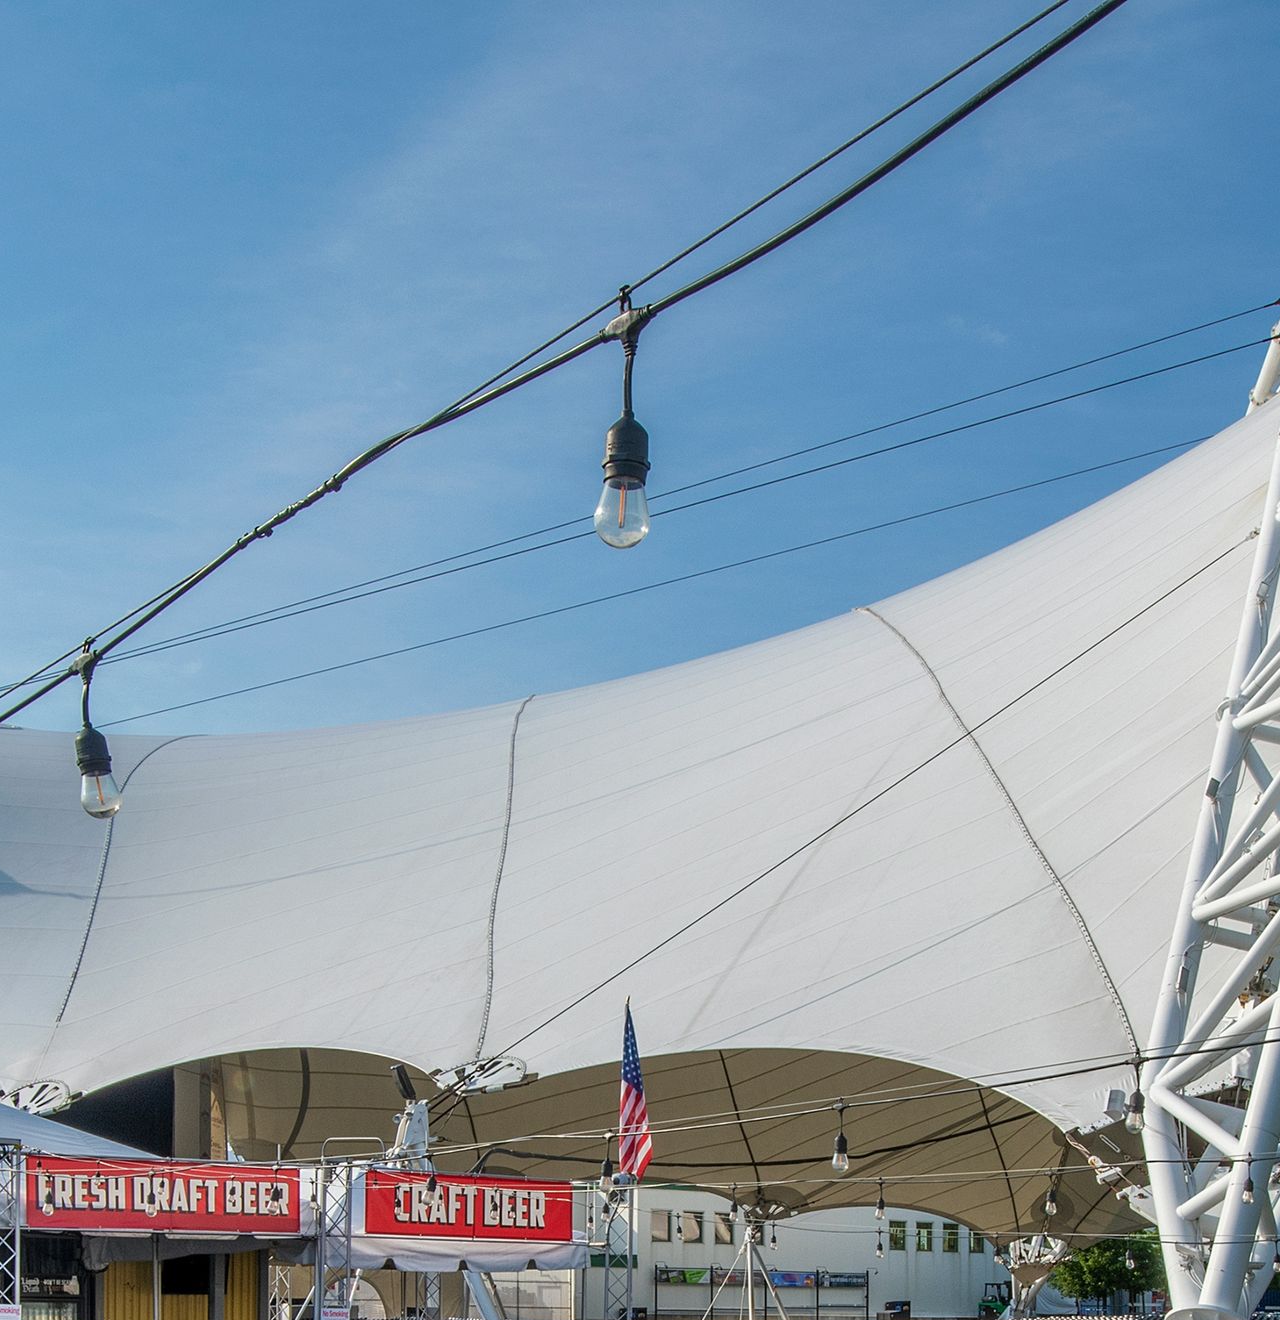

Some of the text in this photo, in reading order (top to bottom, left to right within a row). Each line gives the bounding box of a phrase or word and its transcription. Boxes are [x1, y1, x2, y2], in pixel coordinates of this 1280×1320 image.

[37, 1174, 290, 1217] FRESH DRAFT BEER
[395, 1183, 479, 1226] CRAFT
